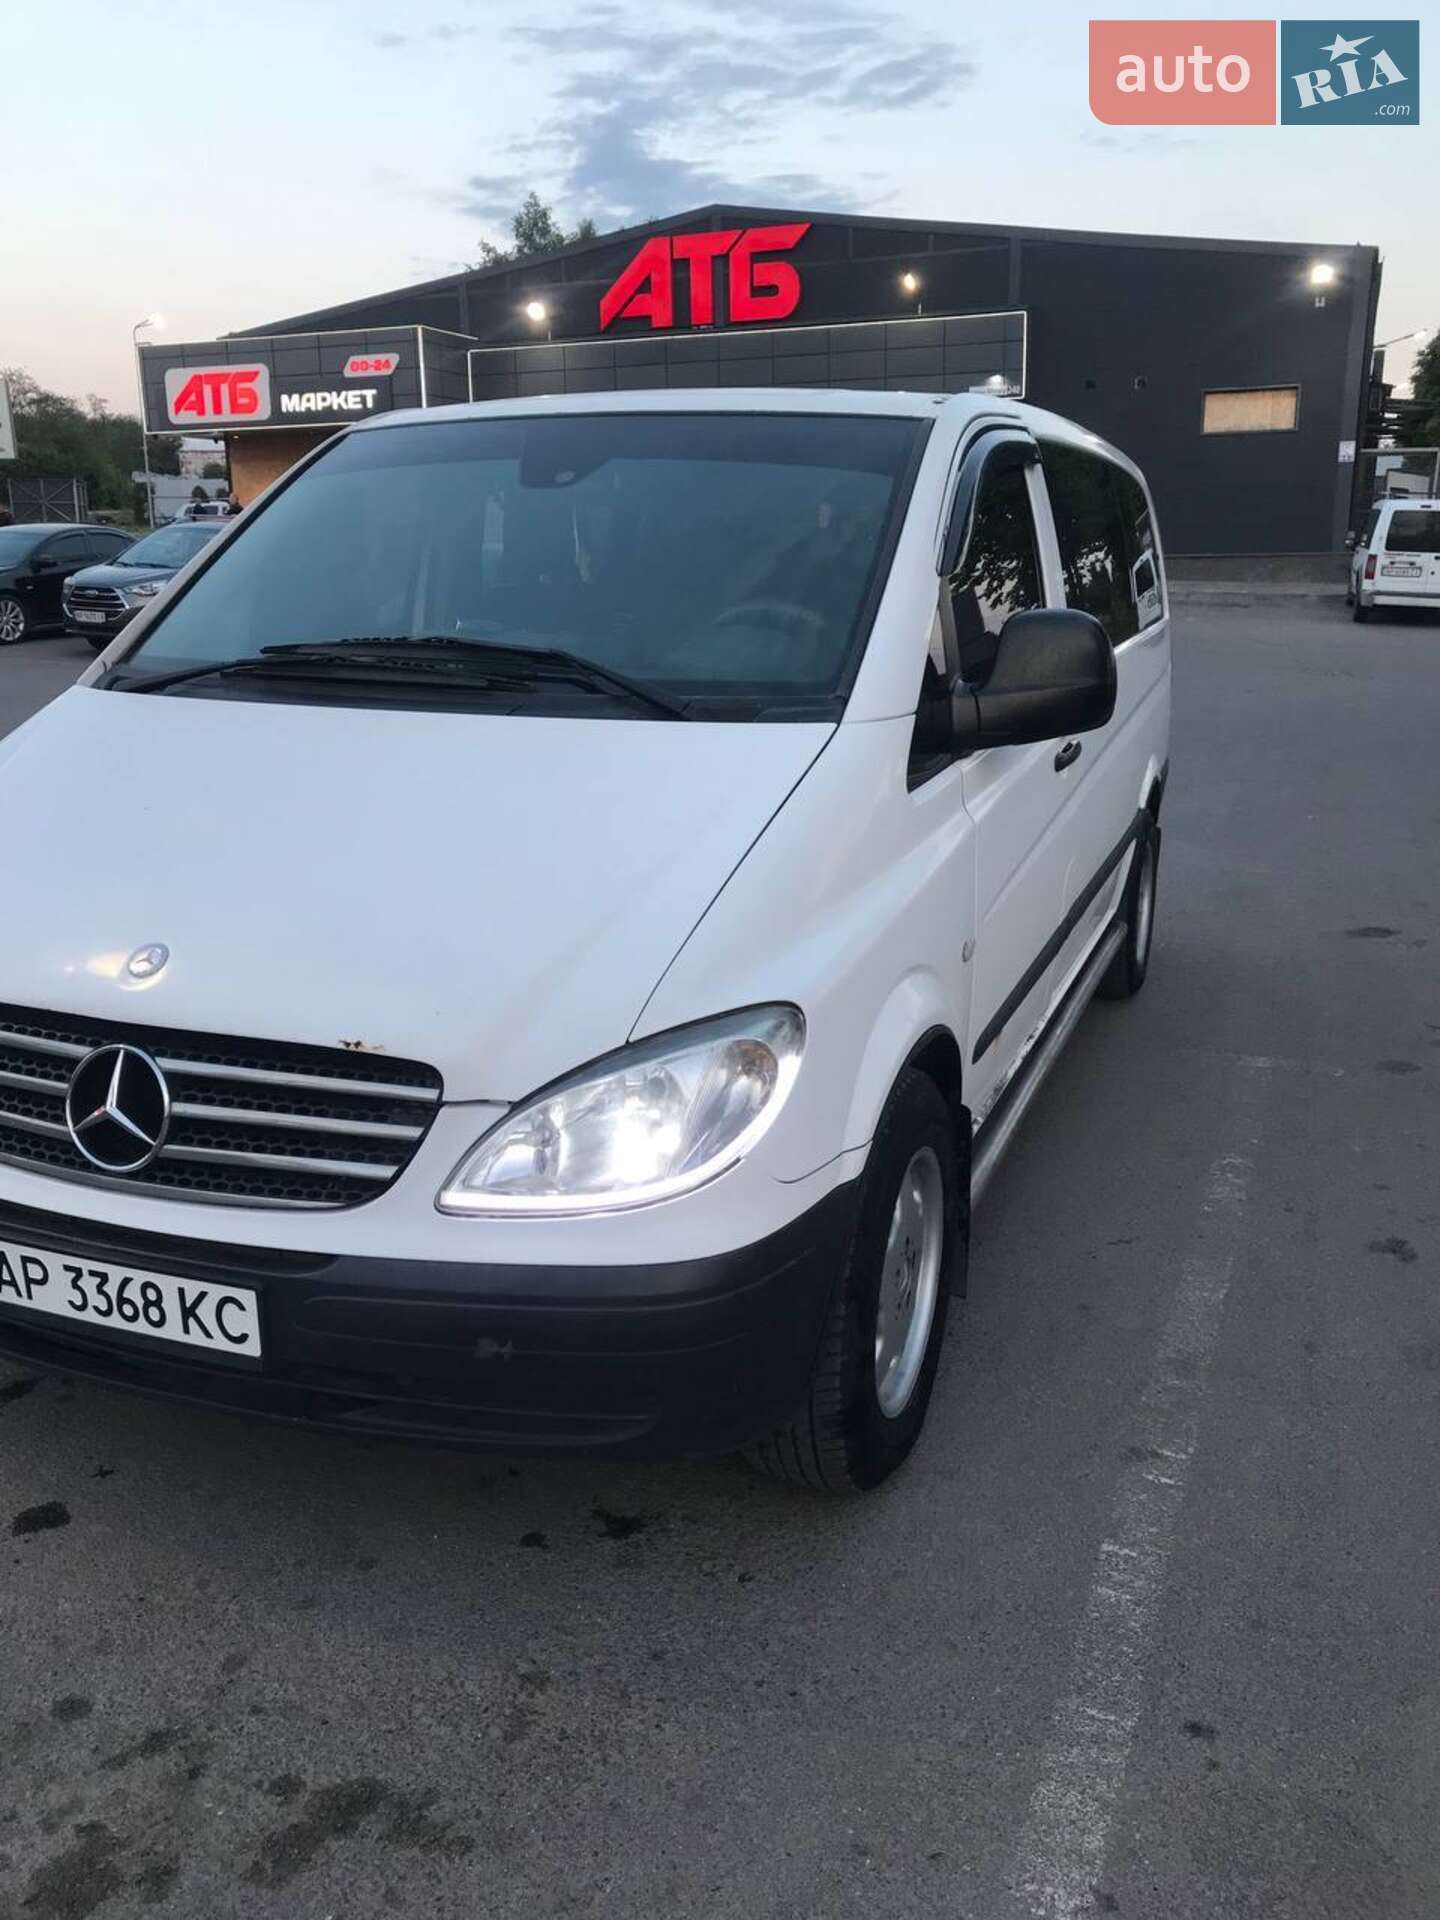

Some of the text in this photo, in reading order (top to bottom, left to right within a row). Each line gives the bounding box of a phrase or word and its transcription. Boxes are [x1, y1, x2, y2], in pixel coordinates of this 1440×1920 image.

[600, 223, 812, 333] АТБ
[350, 359, 391, 372] 00-24
[173, 370, 260, 416] АТБ
[280, 389, 377, 413] МАРКЕТ
[63, 1264, 167, 1328] 3368
[177, 1286, 249, 1344] KC
